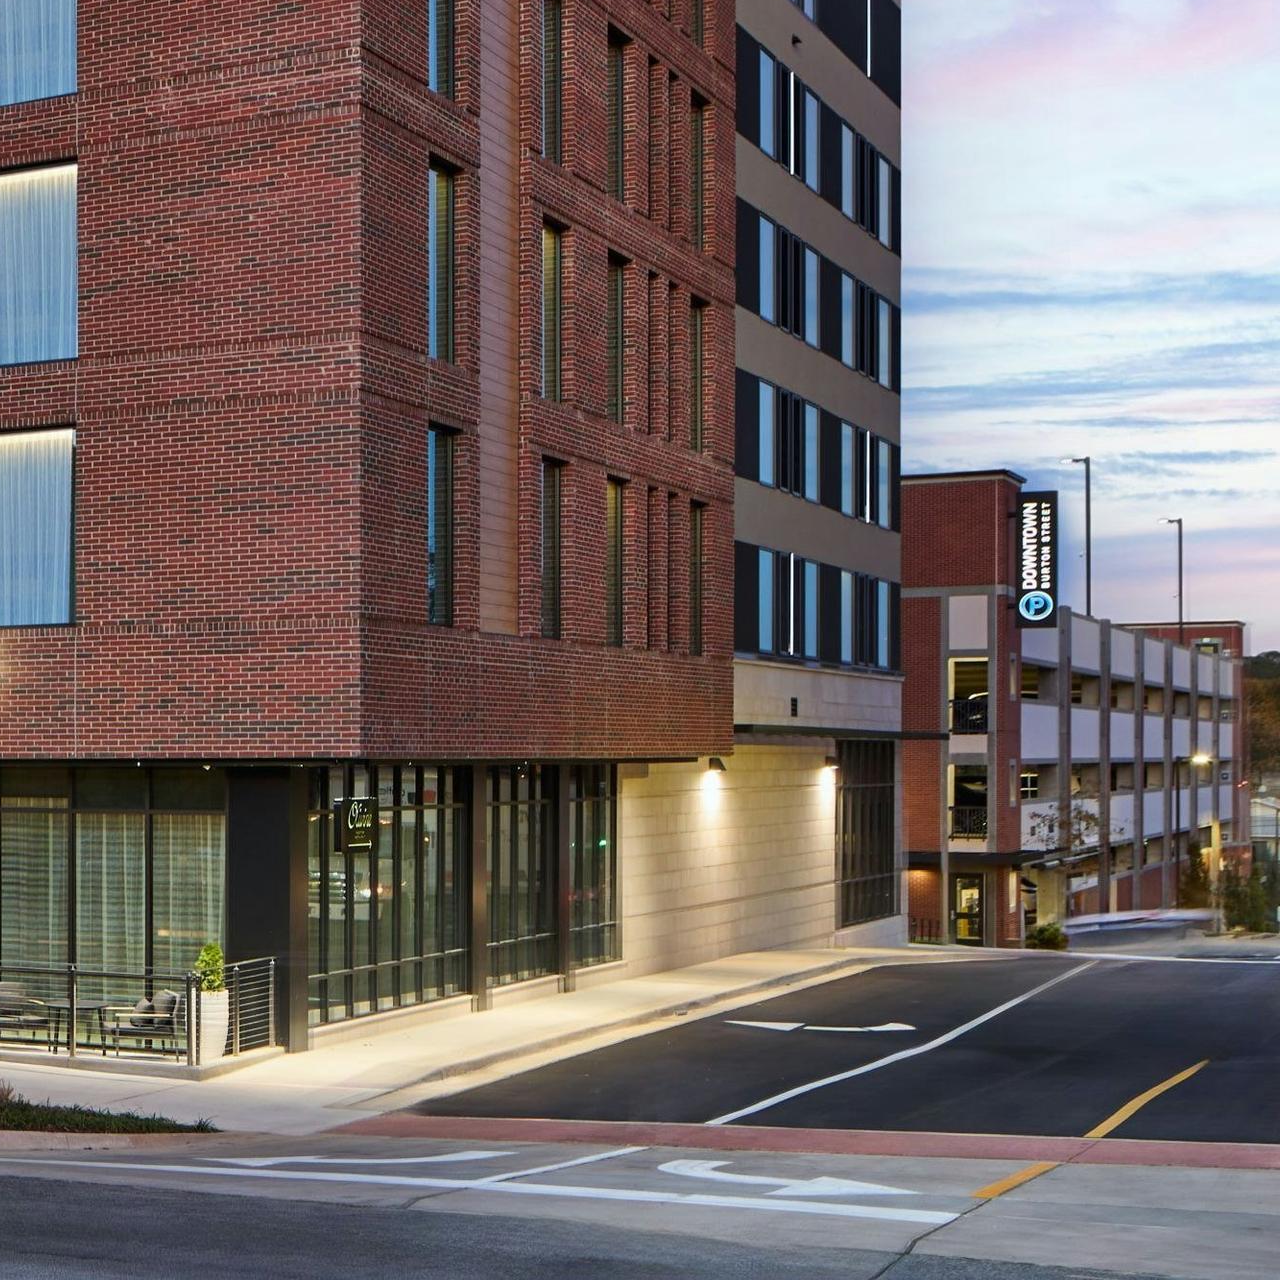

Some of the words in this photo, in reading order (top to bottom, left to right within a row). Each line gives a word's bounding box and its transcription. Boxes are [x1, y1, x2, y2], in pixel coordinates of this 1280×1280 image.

[1041, 502, 1051, 543] STREET
[1022, 502, 1037, 590] DOWNTOWN
[1041, 546, 1051, 589] BURTON
